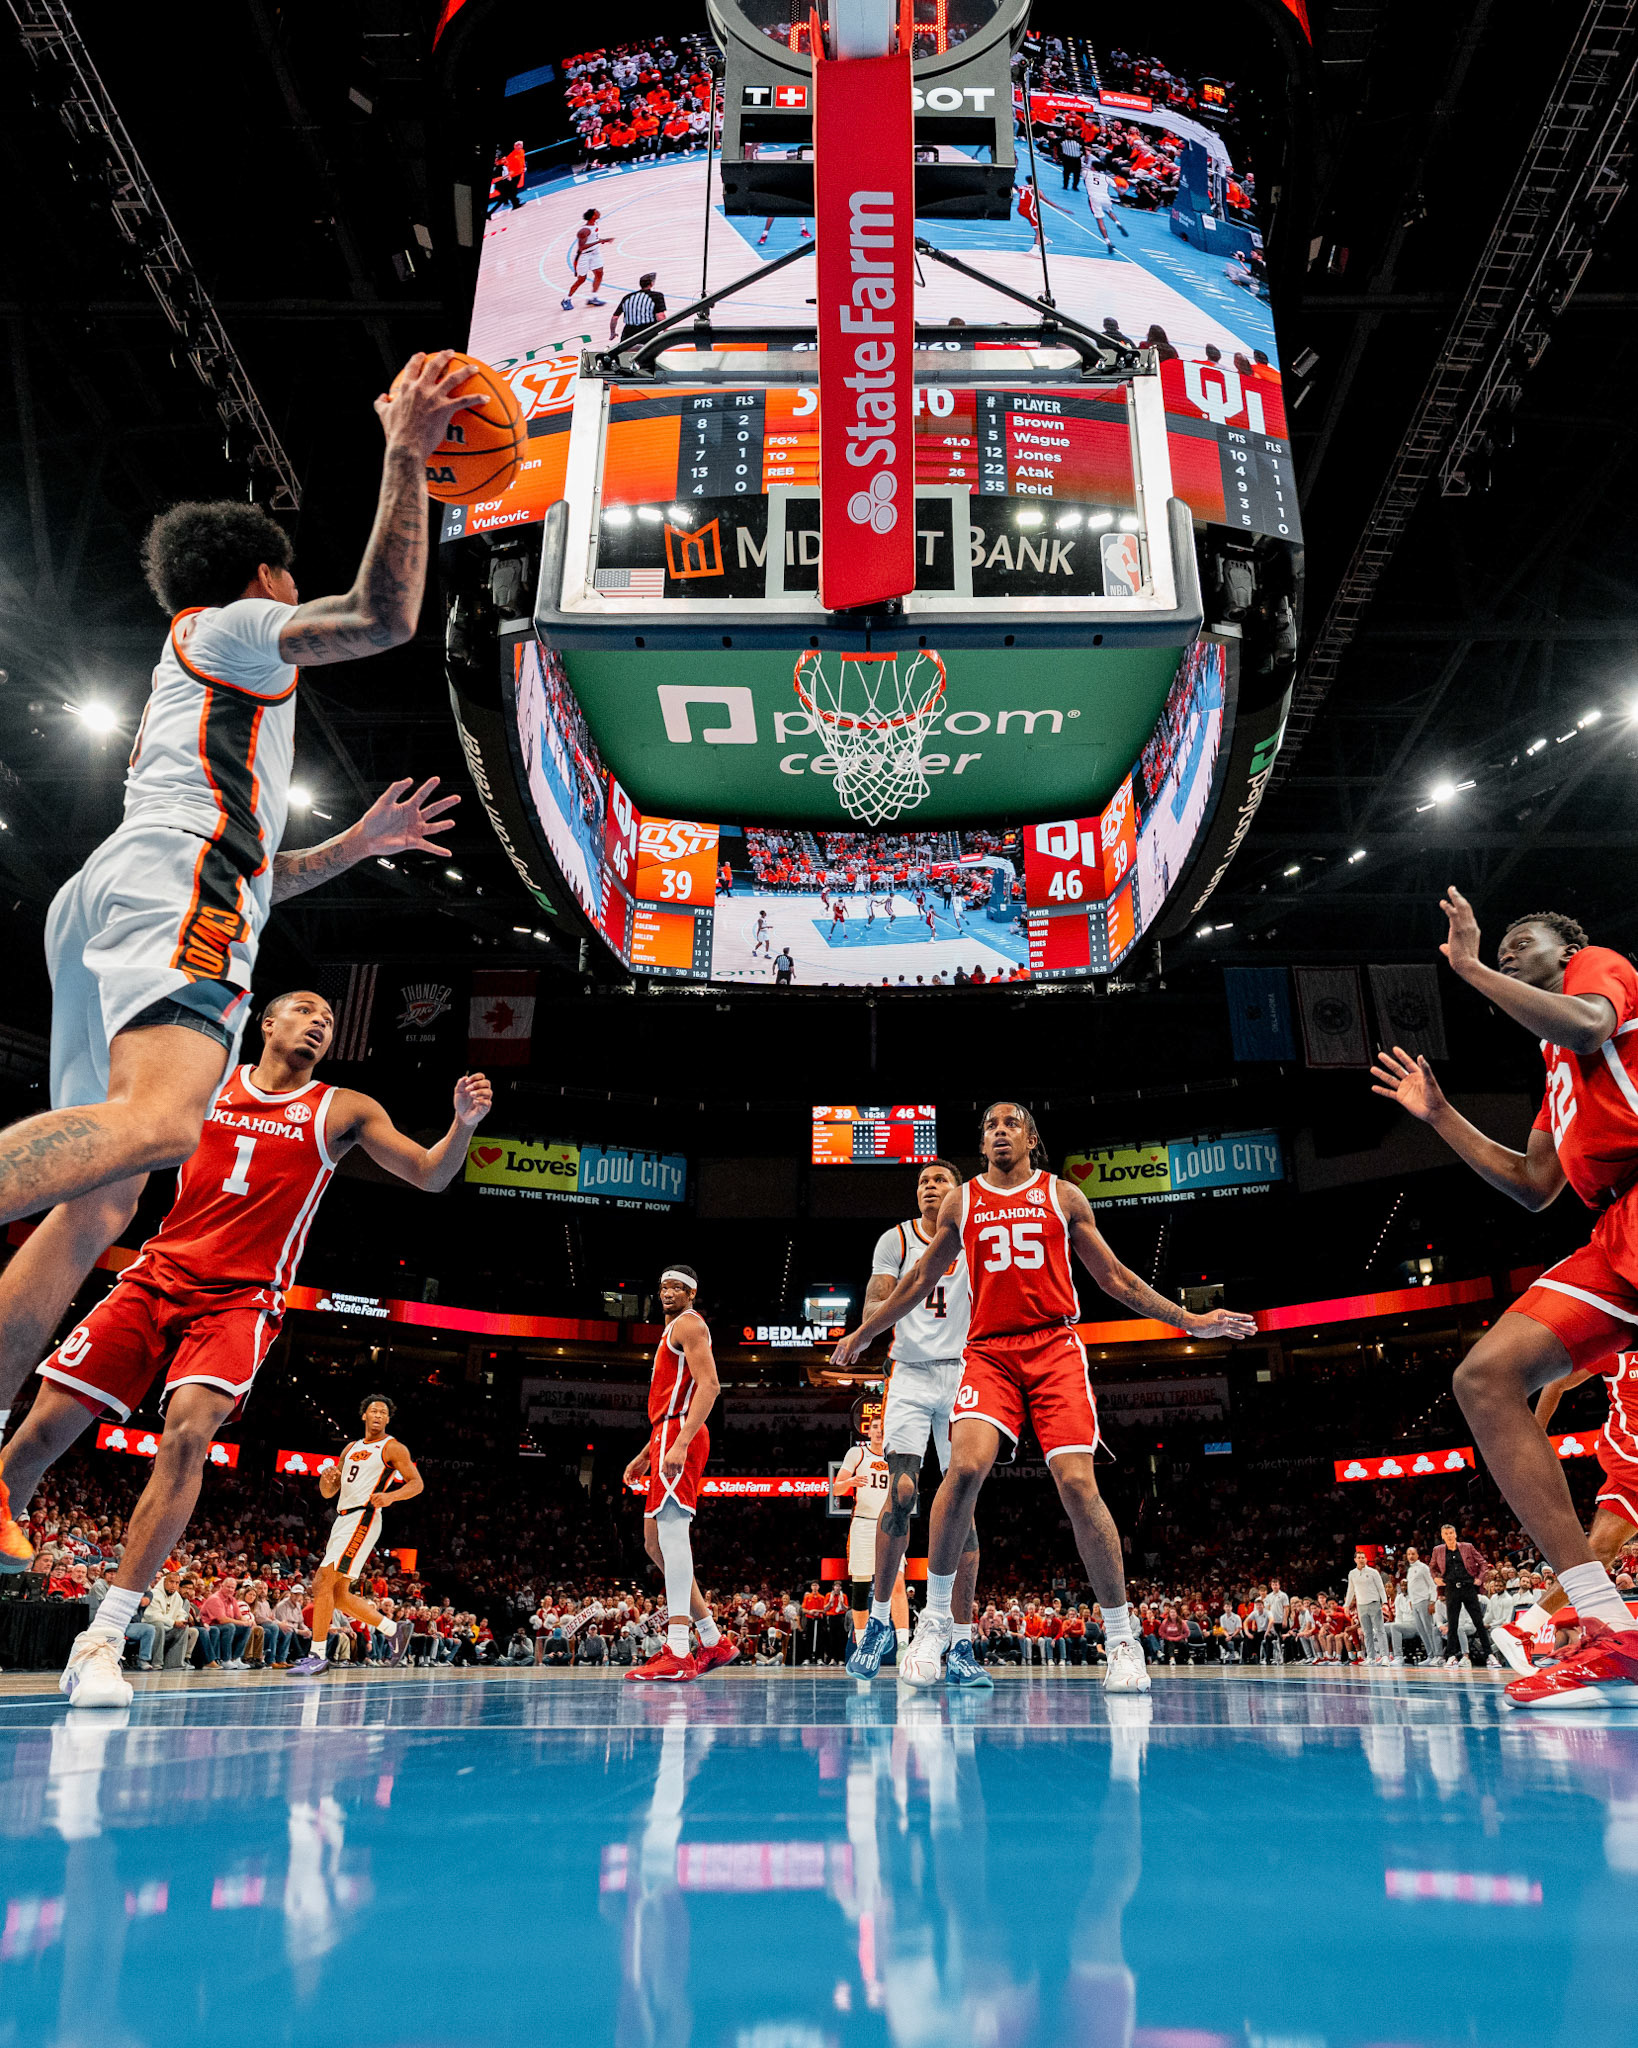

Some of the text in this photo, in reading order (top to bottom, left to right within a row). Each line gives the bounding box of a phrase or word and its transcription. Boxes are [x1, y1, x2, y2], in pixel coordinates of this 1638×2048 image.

[839, 191, 897, 467] StateFarm
[694, 396, 754, 409] PTS FLS
[1013, 398, 1062, 414] PLAYER
[697, 415, 749, 429] 8 2
[989, 414, 1065, 430] 1 Brown
[697, 431, 749, 444] 1 0
[768, 437, 798, 446] FG%
[943, 437, 970, 447] 41.0
[988, 430, 1071, 447] 5 Wague
[1228, 432, 1282, 453] PTS FLS
[695, 448, 746, 461] 7 1
[768, 452, 787, 461] TO
[952, 451, 962, 461] 5
[985, 447, 1062, 463] 12 Jones
[1229, 450, 1279, 470] 10 1
[691, 464, 748, 478] 13 0
[768, 467, 795, 476] REB
[948, 468, 966, 477] 26
[984, 463, 1054, 479] 22 Atak
[1235, 466, 1281, 486] 4 1
[692, 481, 747, 495] 4 0
[985, 480, 1005, 492] 35
[1015, 482, 1053, 496] Reid
[1237, 481, 1283, 502] 9 1
[451, 500, 503, 519] 9 Roy
[1240, 498, 1285, 518] 3 1
[446, 510, 530, 536] 19 Vukovic
[1242, 515, 1289, 535] 5 0
[1109, 584, 1128, 596] NBA
[612, 840, 629, 881] 46
[1112, 839, 1128, 882] 39
[659, 868, 693, 900] 39
[1048, 869, 1084, 901] 46
[1029, 909, 1049, 918] PLAYER
[400, 983, 453, 1003] THUNDER
[287, 1104, 310, 1121] SEC
[834, 1108, 852, 1119] 39
[896, 1108, 915, 1119] 46
[221, 1134, 258, 1197] 1
[1174, 1144, 1226, 1184] LOUD
[1232, 1143, 1278, 1174] CITY
[583, 1156, 682, 1195] LOUD CITY
[478, 1186, 671, 1212] BRING THE THUNDER EXIT NOW
[1027, 1189, 1046, 1203] SEC
[1091, 1184, 1271, 1210] ING THE THUNDER EXIT NOW
[974, 1207, 1047, 1224] OKLAHOMA
[978, 1223, 1045, 1273] 35
[331, 1292, 369, 1304] PRESENTED
[925, 1286, 947, 1318] 4
[332, 1300, 388, 1318] StateFarm
[756, 1326, 828, 1341] BEDLAM
[771, 1340, 814, 1348] BASKETBALL
[346, 1465, 360, 1483] 9
[870, 1473, 888, 1490] 19
[719, 1481, 771, 1493] StateFarm
[345, 1524, 369, 1558] COWBOYS
[565, 1605, 596, 1634] DEFENSE
